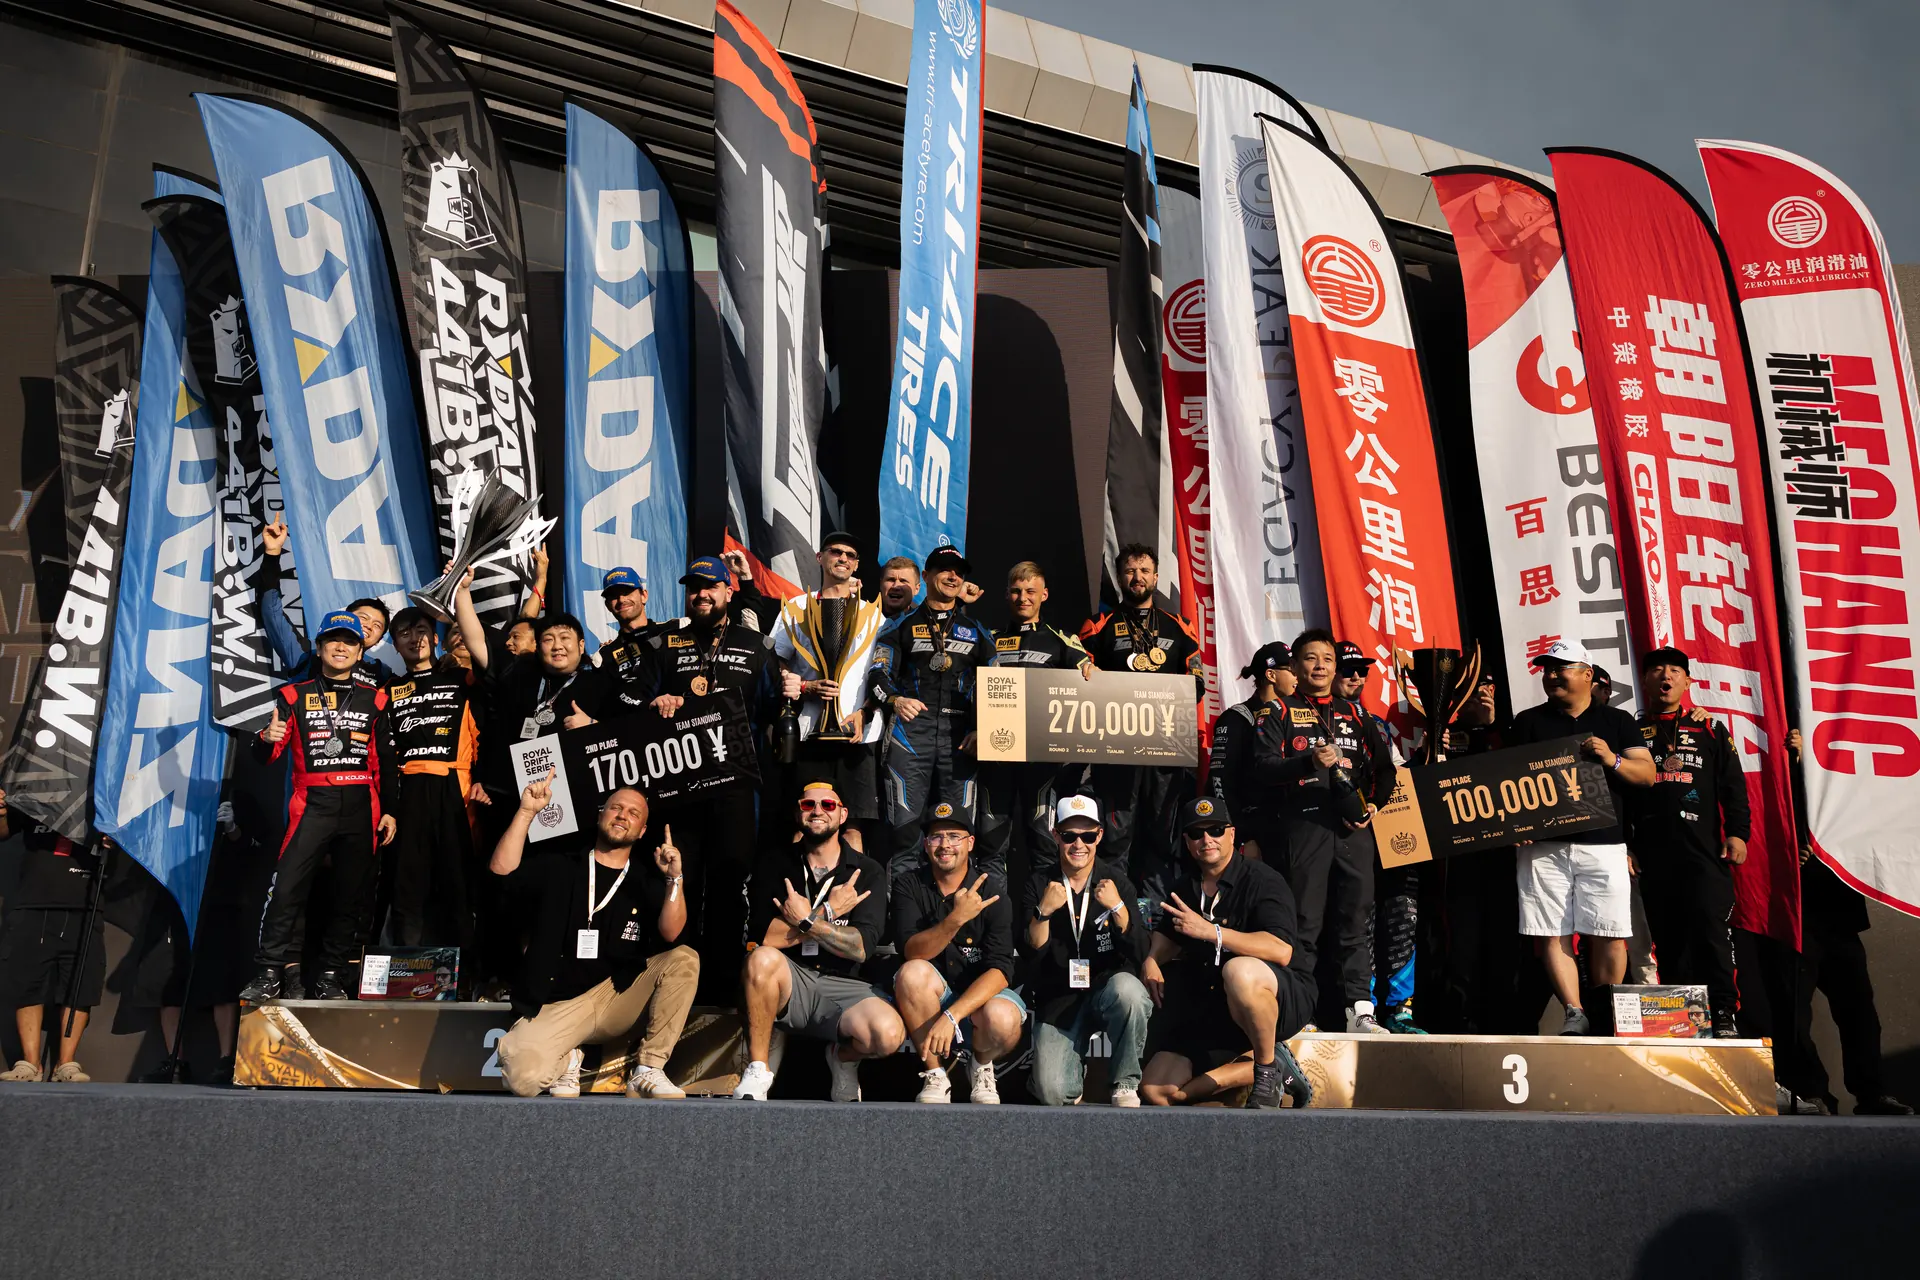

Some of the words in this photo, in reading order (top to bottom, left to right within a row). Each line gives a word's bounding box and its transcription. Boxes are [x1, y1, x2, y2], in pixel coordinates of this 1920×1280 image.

[913, 30, 937, 246] www.tri-acetyre.com
[1741, 252, 1868, 278] 零公里润滑油
[1744, 279, 1771, 290] ZERO
[1771, 275, 1815, 287] MILEAGE
[1816, 271, 1871, 282] LUBRICANT
[920, 66, 968, 523] TRI-ACE
[1607, 307, 1649, 437] 中策橡胶
[895, 305, 930, 491] TIRES
[1633, 463, 1663, 584] CHAO
[394, 684, 412, 696] ROYAL
[987, 691, 1017, 700] SERIES
[1048, 687, 1058, 695] 1ST
[1059, 687, 1078, 696] PLACE
[1134, 690, 1147, 698] TEAM
[1147, 691, 1175, 700] STANDINGS
[393, 692, 455, 709] RYDANZ
[675, 720, 690, 731] TEAM
[691, 712, 722, 728] STANDINGS
[1048, 699, 1155, 740] 270,000
[1162, 704, 1175, 737] ¥
[522, 746, 553, 761] ROYAL
[585, 744, 598, 754] 2ND
[598, 738, 619, 751] PLACE
[313, 757, 362, 766] RYDANZ
[523, 756, 549, 769] DRIFT
[588, 732, 702, 793] 170,000
[706, 725, 729, 763] ¥
[1528, 760, 1544, 771] TEAM
[1544, 754, 1575, 768] STANDINGS
[525, 762, 556, 776] SERIES
[721, 776, 735, 784] World
[1438, 779, 1452, 789] 3RD
[1452, 775, 1472, 786] PLACE
[658, 790, 679, 798] TIANJIN
[1442, 772, 1558, 825] 100,000
[1560, 767, 1583, 802] ¥
[1492, 830, 1504, 838] JULY
[1513, 825, 1534, 833] TIANJIN
[1453, 837, 1470, 845] ROUND
[620, 932, 641, 941] ERIES
[1096, 931, 1111, 941] ROY
[1100, 938, 1112, 946] DRI
[481, 1028, 504, 1077] 2
[1502, 1054, 1529, 1104] 3
